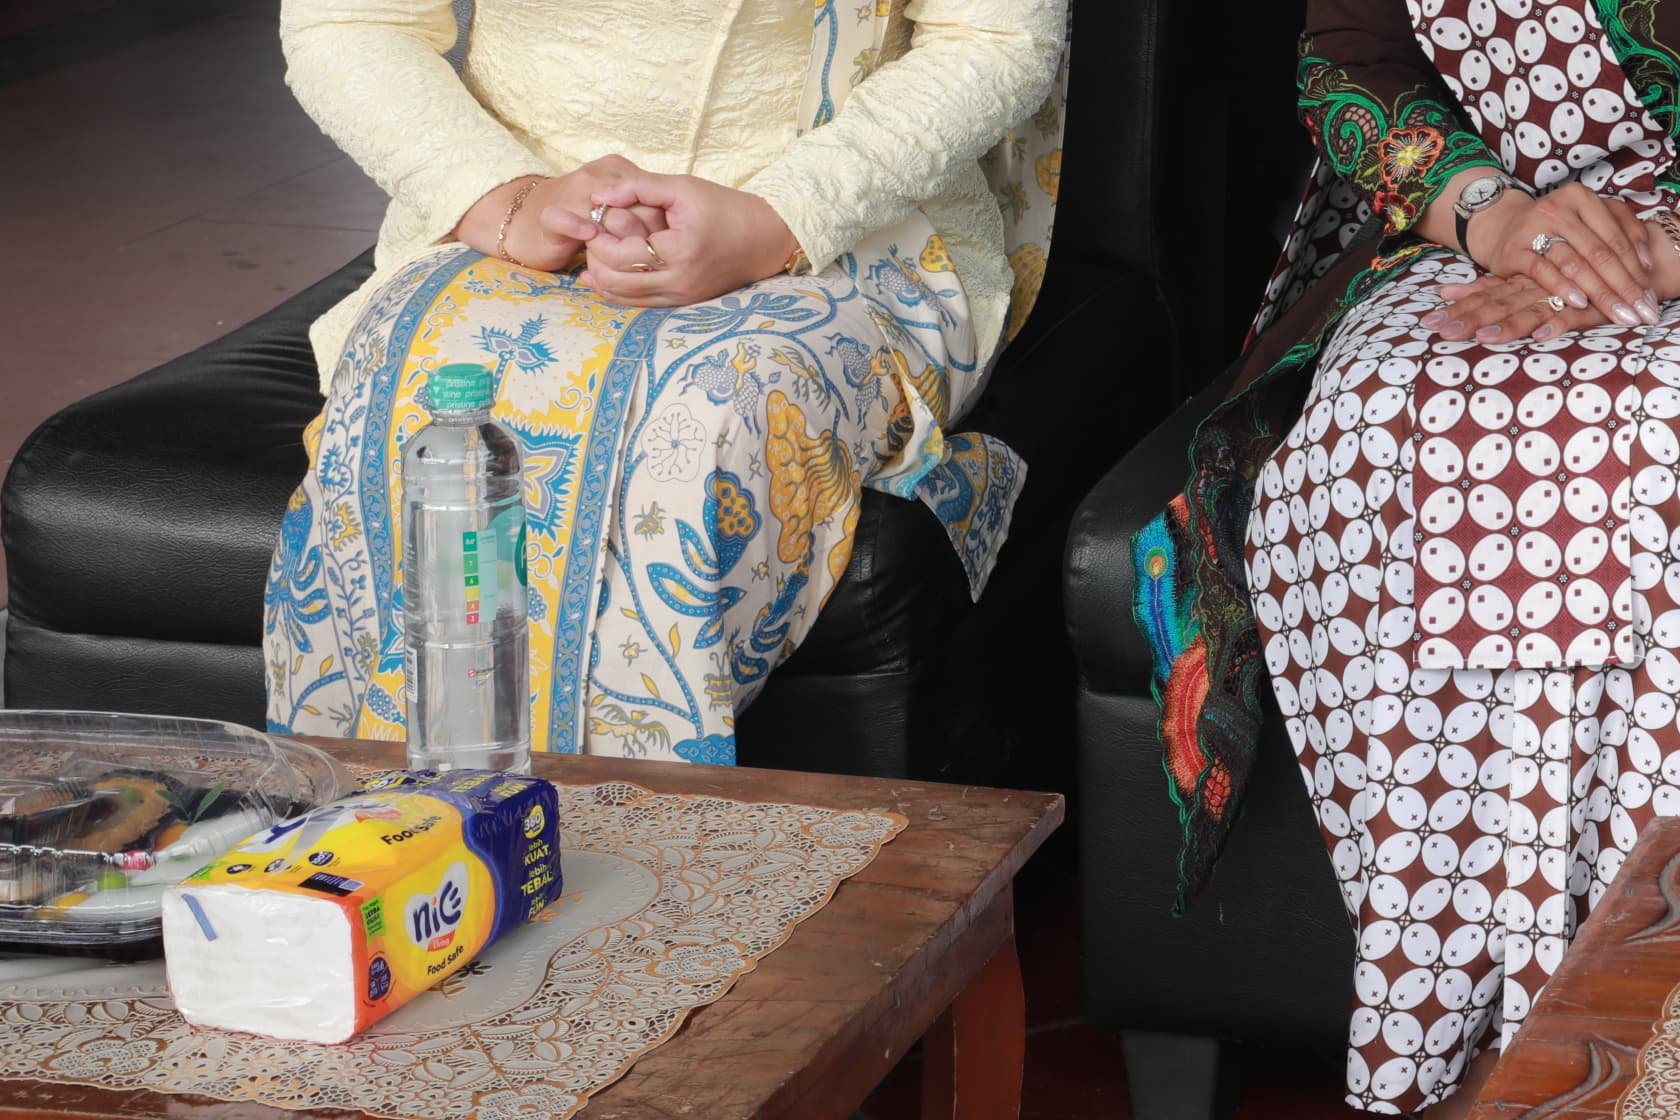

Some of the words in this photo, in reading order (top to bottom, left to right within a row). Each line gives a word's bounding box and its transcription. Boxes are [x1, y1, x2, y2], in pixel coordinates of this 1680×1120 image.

[523, 812, 541, 831] 360
[427, 959, 446, 976] Food
[447, 944, 465, 965] Safe
